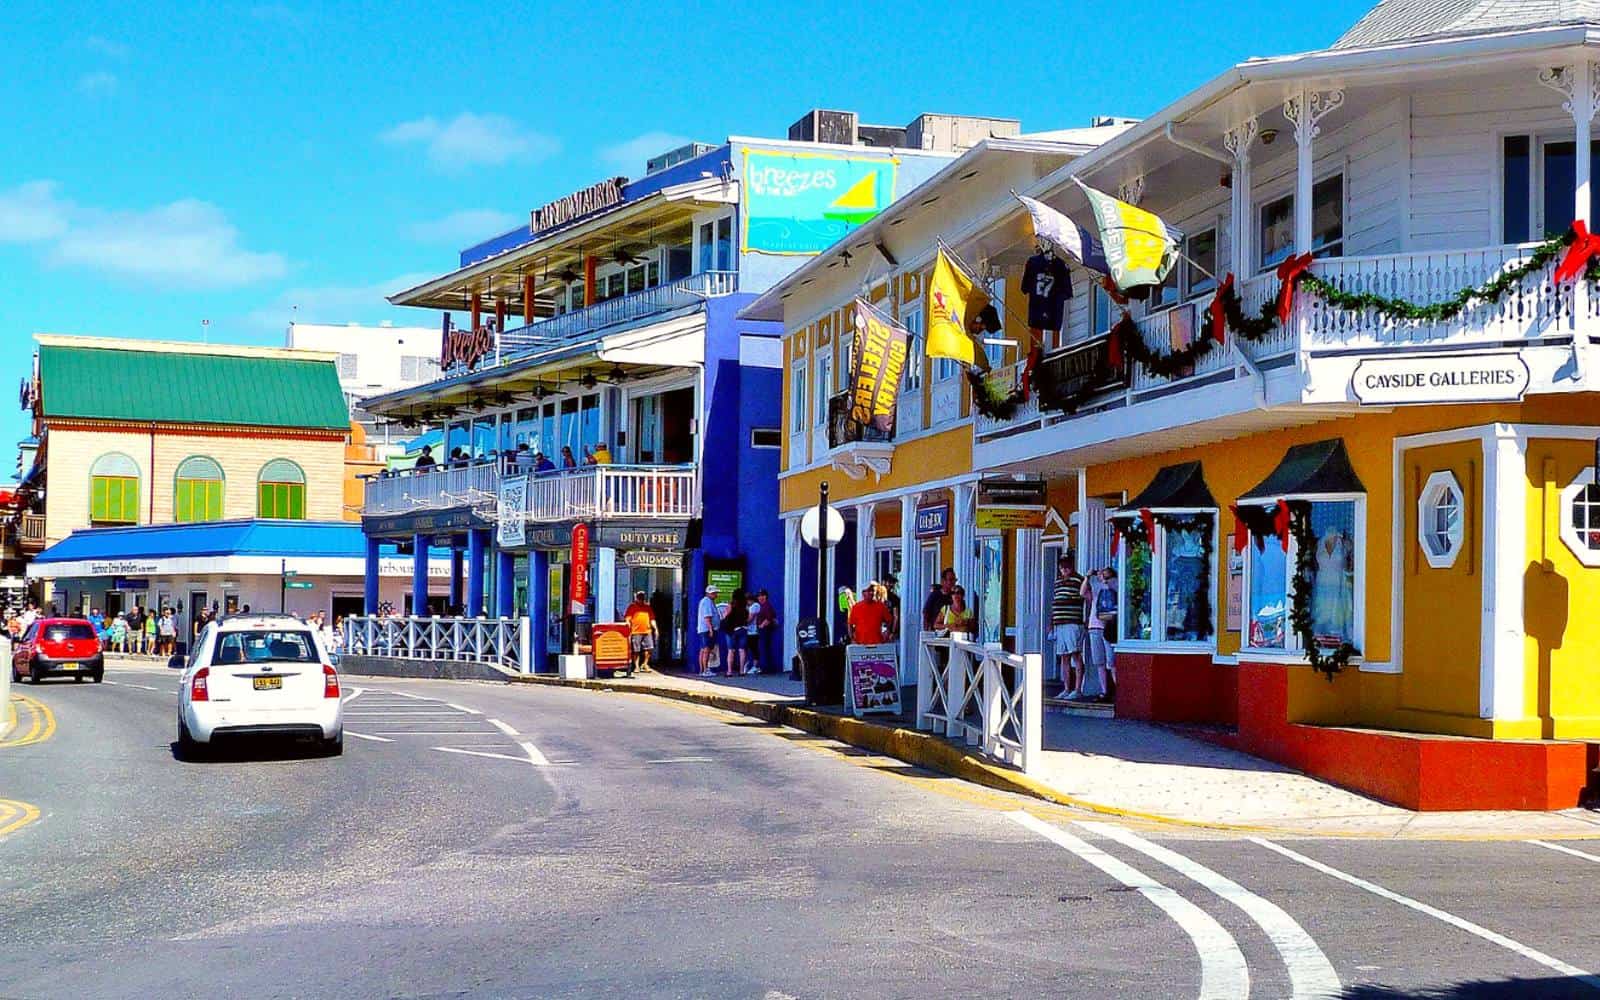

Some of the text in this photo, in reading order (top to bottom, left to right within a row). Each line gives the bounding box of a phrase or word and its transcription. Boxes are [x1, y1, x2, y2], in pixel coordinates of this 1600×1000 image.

[750, 162, 838, 192] breezes
[531, 177, 622, 233] LANDMARK
[441, 311, 491, 370] breezes
[1365, 369, 1515, 389] CAYSIDE GALLERIES
[577, 528, 585, 560] CUBAN
[620, 532, 679, 545] DUTY FREE
[630, 552, 682, 565] LANDMARK
